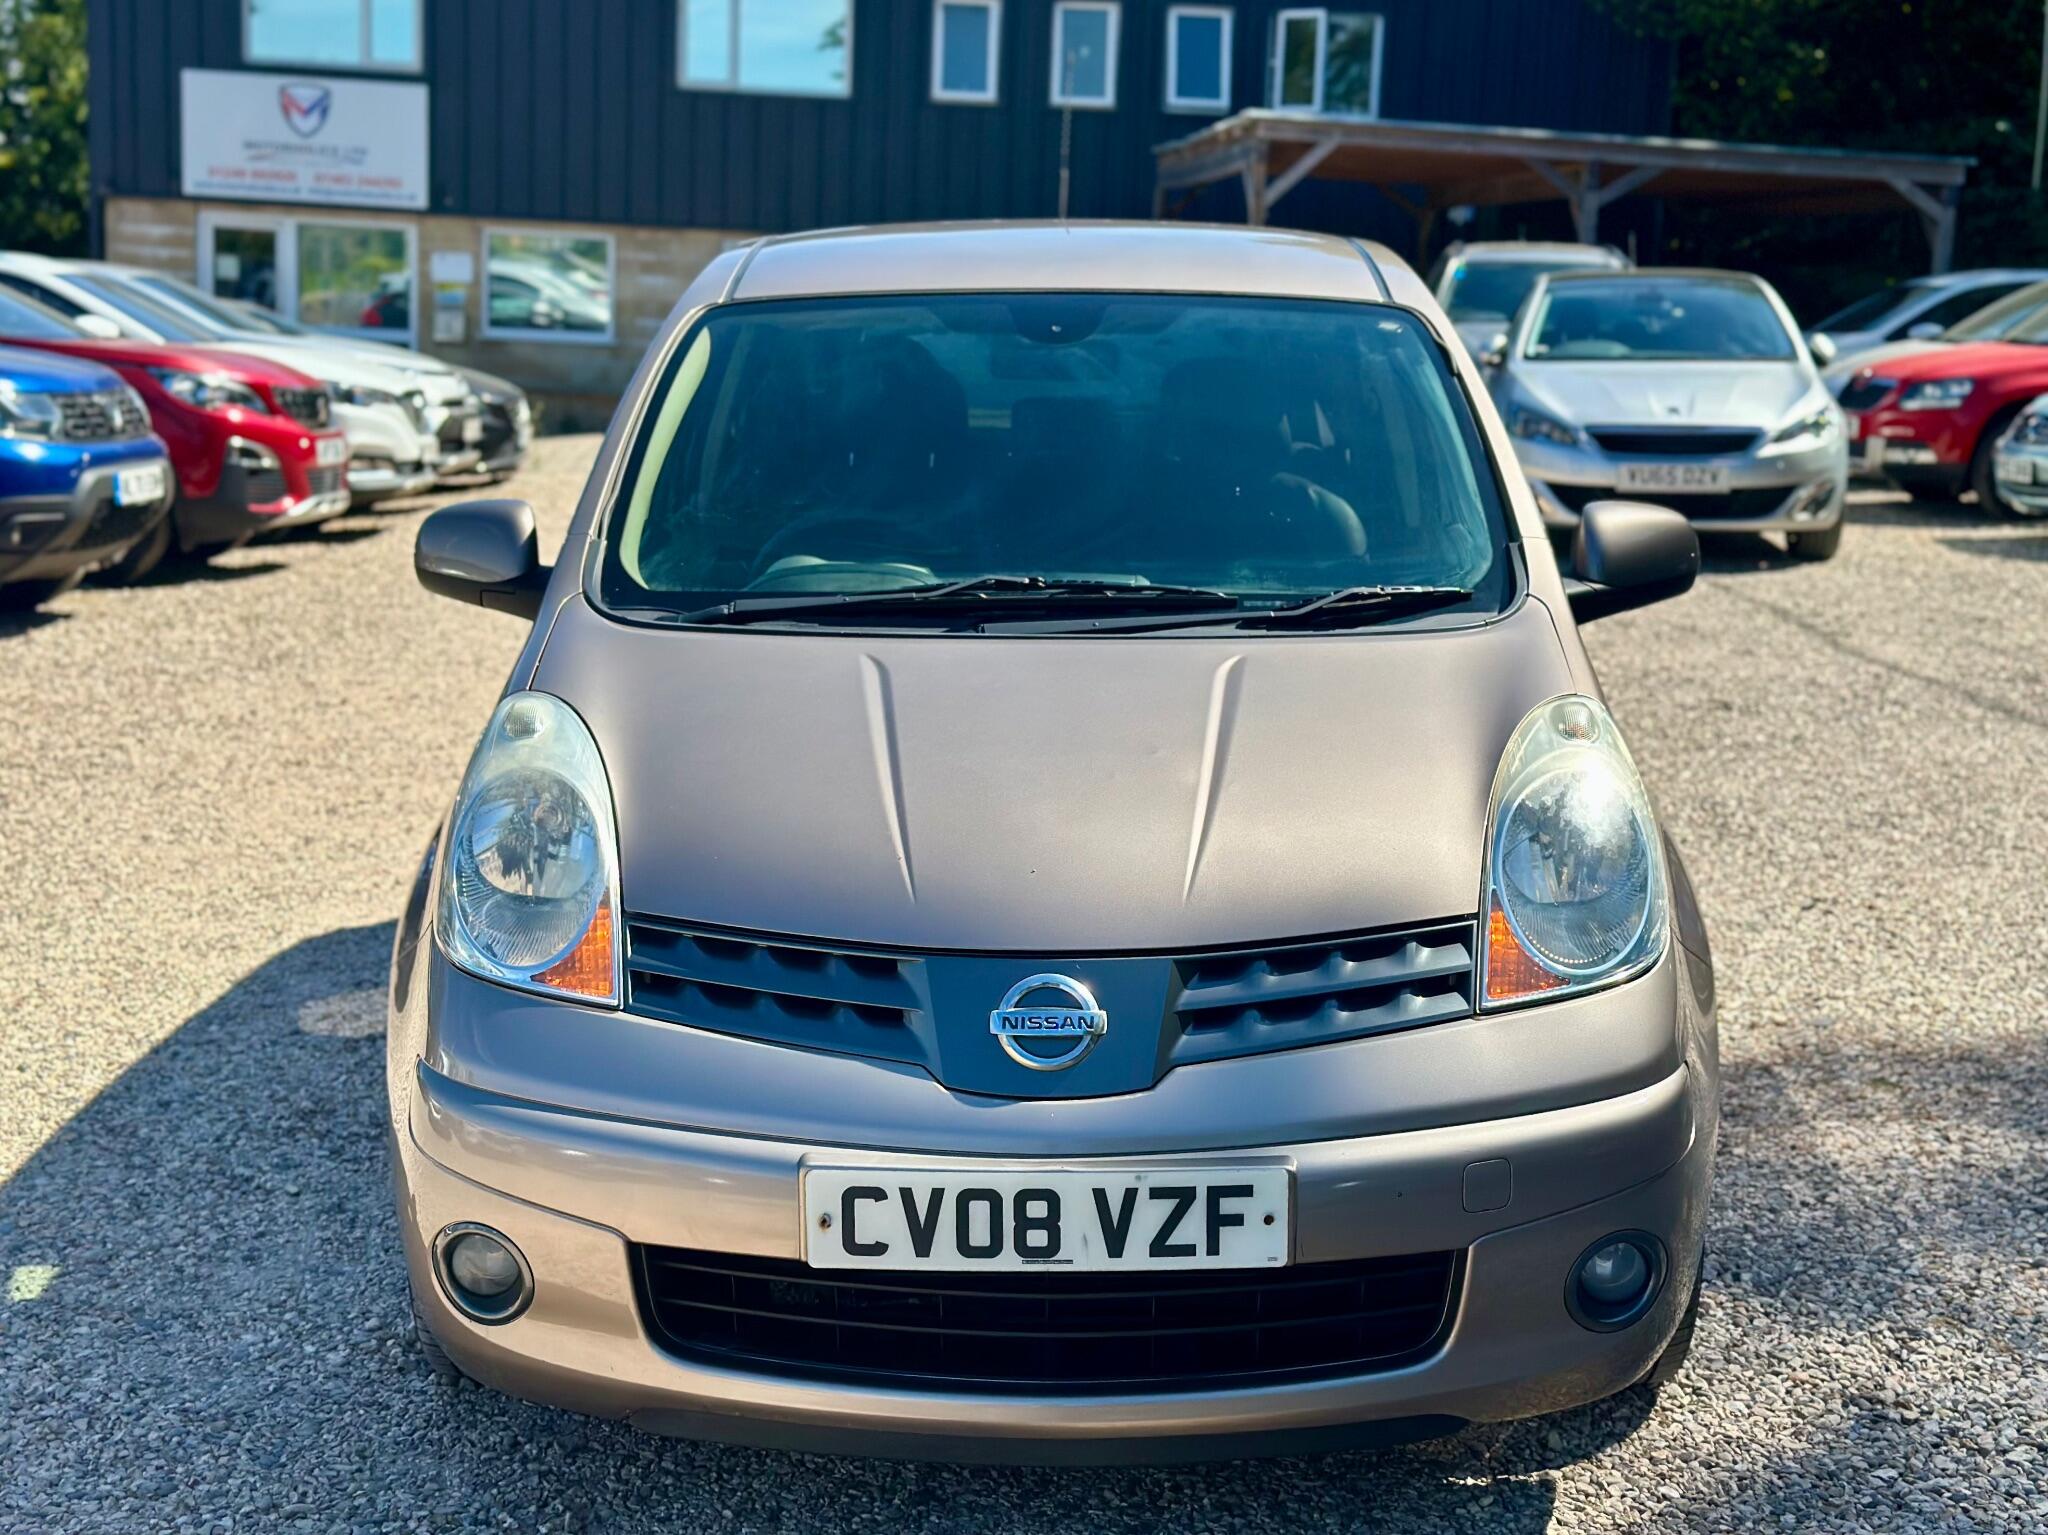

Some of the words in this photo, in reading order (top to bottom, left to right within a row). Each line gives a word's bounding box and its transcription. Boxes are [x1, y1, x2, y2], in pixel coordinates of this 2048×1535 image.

[1001, 1016, 1094, 1030] NISSAN
[841, 1186, 1062, 1258] CV08
[1092, 1184, 1254, 1258] VZF
